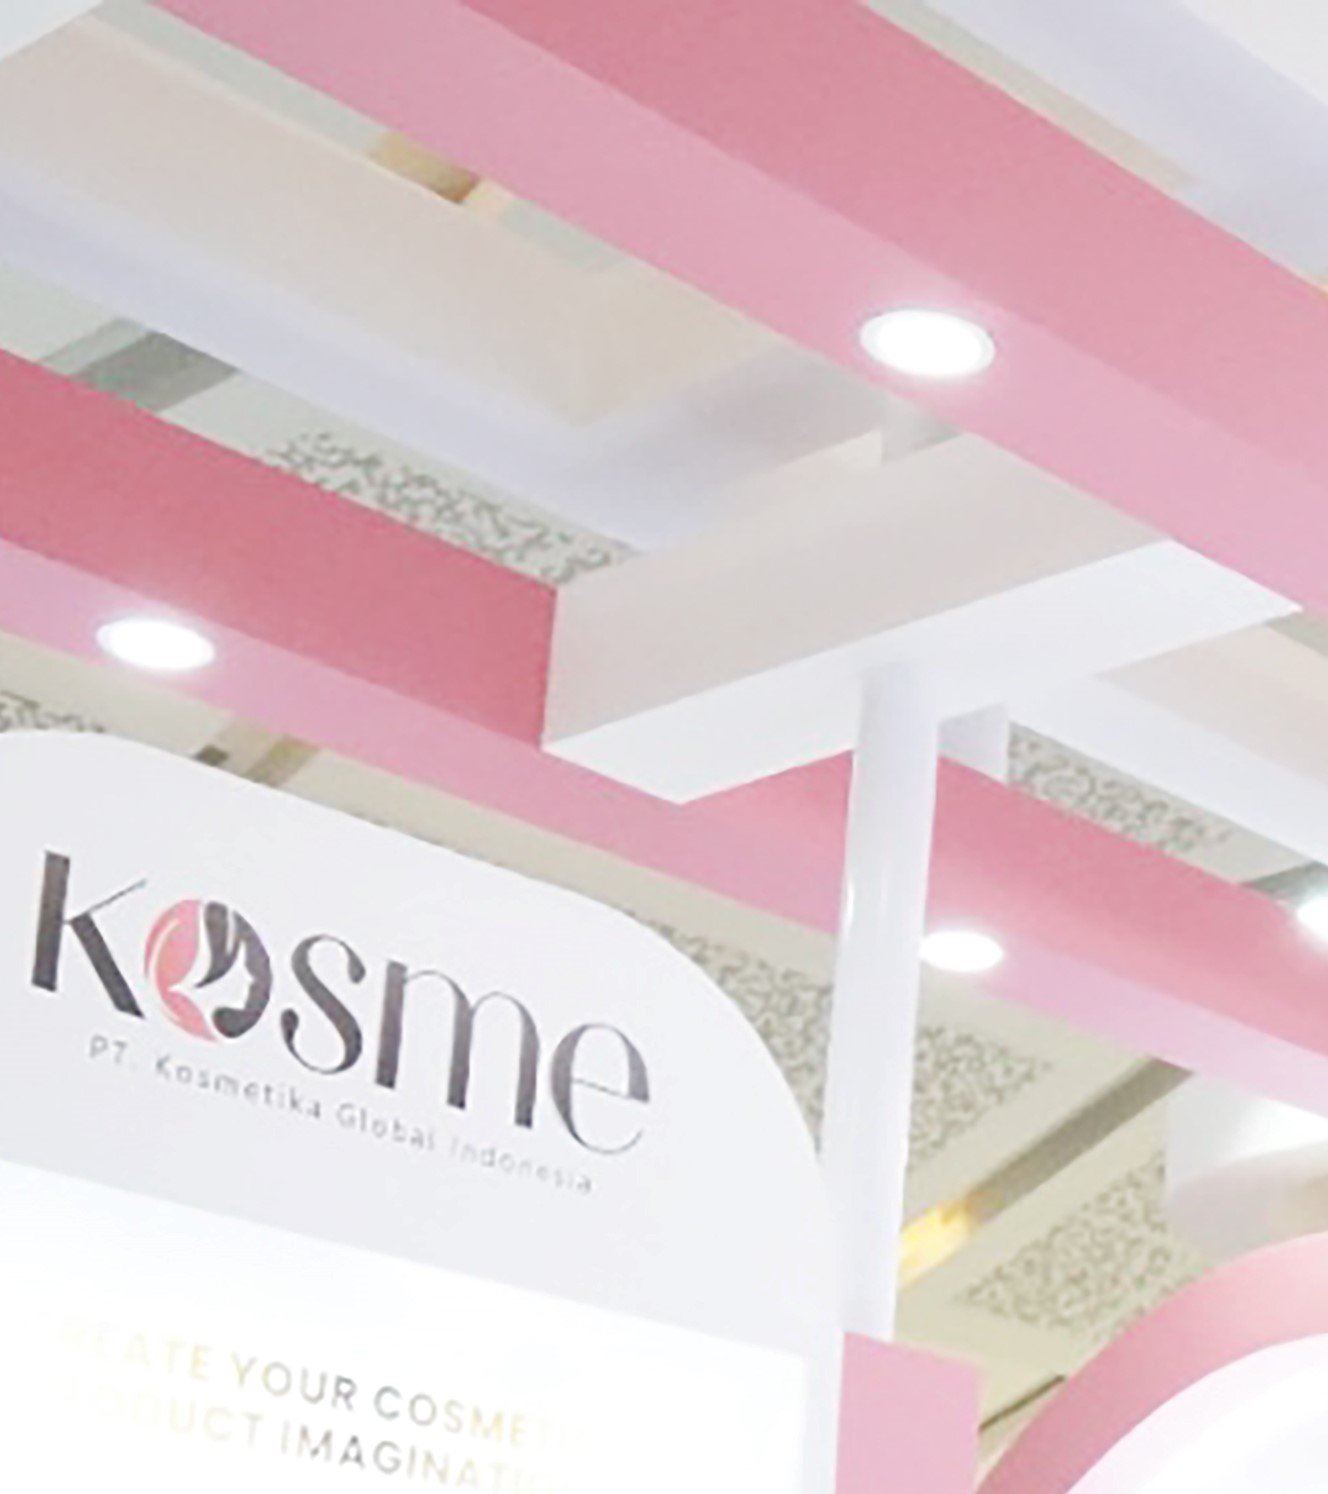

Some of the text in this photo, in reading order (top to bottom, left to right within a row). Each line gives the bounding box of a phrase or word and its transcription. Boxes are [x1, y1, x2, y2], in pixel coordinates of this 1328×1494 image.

[155, 1053, 323, 1120] Kosmetika
[336, 1101, 437, 1154] Global
[450, 1137, 594, 1194] Indonesia
[230, 1350, 359, 1413] YOUR
